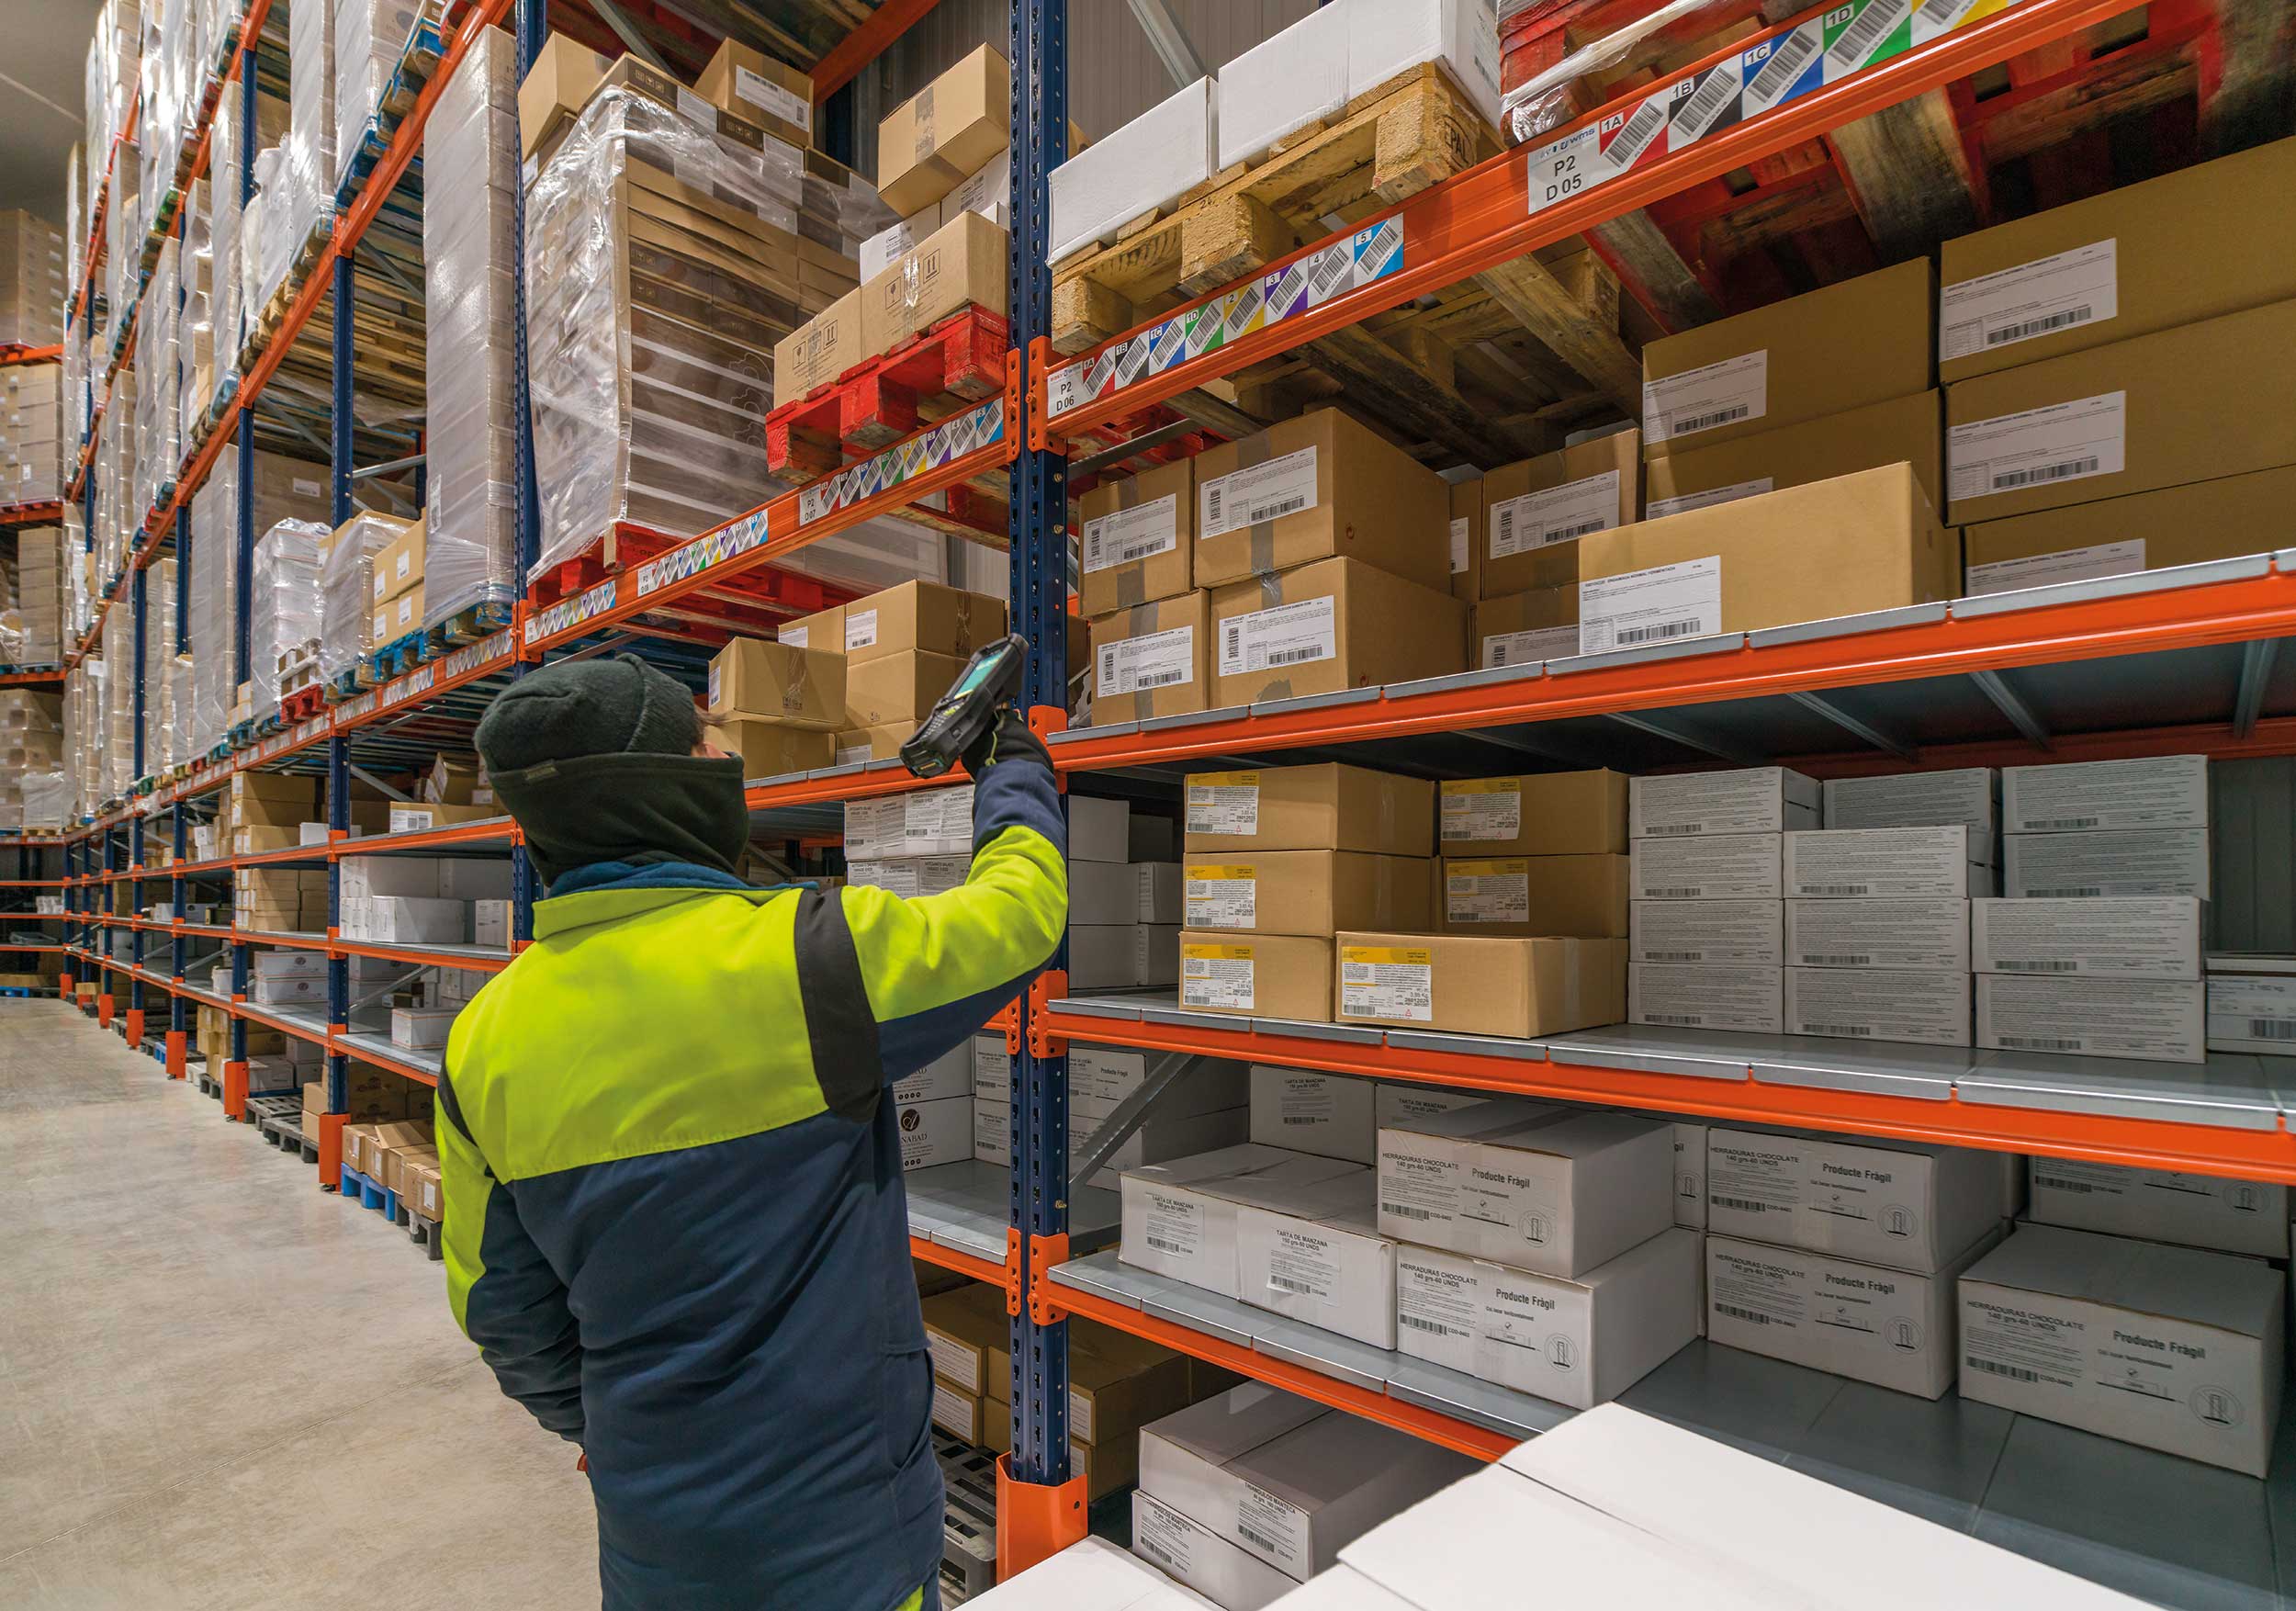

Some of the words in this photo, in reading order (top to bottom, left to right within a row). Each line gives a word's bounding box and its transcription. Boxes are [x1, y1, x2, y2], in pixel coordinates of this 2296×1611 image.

[1829, 8, 1850, 25] 1D
[1748, 46, 1767, 63] 1C
[1673, 83, 1691, 97] 1B
[1604, 116, 1621, 130] 1A
[1554, 155, 1575, 176] P2
[1547, 185, 1558, 201] D
[1562, 174, 1581, 194] 05
[1360, 233, 1367, 242] 5
[1313, 254, 1320, 263] 4
[1270, 276, 1275, 284] 3
[1229, 294, 1234, 302] 2
[1187, 310, 1198, 321] 1D
[1152, 328, 1162, 336] 1C
[1118, 344, 1127, 354] 1B
[1061, 381, 1072, 395] P2
[1057, 400, 1063, 411] D
[1064, 395, 1075, 408] 06
[808, 499, 814, 507] P2
[809, 509, 816, 519] 07
[1674, 1143, 1684, 1153] gil
[1710, 1147, 1755, 1158] HERRADURAS
[1757, 1153, 1799, 1163] CHOCOLATE
[1382, 1153, 1422, 1164] HERRADURAS
[1423, 1158, 1458, 1170] CHOCOLATE
[1472, 1168, 1505, 1183] Producte
[1823, 1163, 1861, 1178] Producte
[1153, 1195, 1165, 1203] TARTA
[1173, 1200, 1194, 1210] MANZANA
[1277, 1230, 1293, 1239] TARTA
[1302, 1235, 1328, 1247] MANZANA
[1715, 1254, 1761, 1268] HERRADURAS
[1762, 1264, 1805, 1279] CHOCOLATE
[1400, 1263, 1439, 1278] HERRADURAS
[1441, 1272, 1477, 1286] CHOCOLATE
[1826, 1274, 1864, 1290] Producte
[1496, 1289, 1529, 1304] Producte
[1967, 1300, 2026, 1318] HERRADURAS
[2028, 1312, 2084, 1331] CHOCOLATE
[2113, 1331, 2165, 1351] Producte
[1273, 1496, 1296, 1514] MANTECA
[1171, 1515, 1190, 1532] MANTECA
